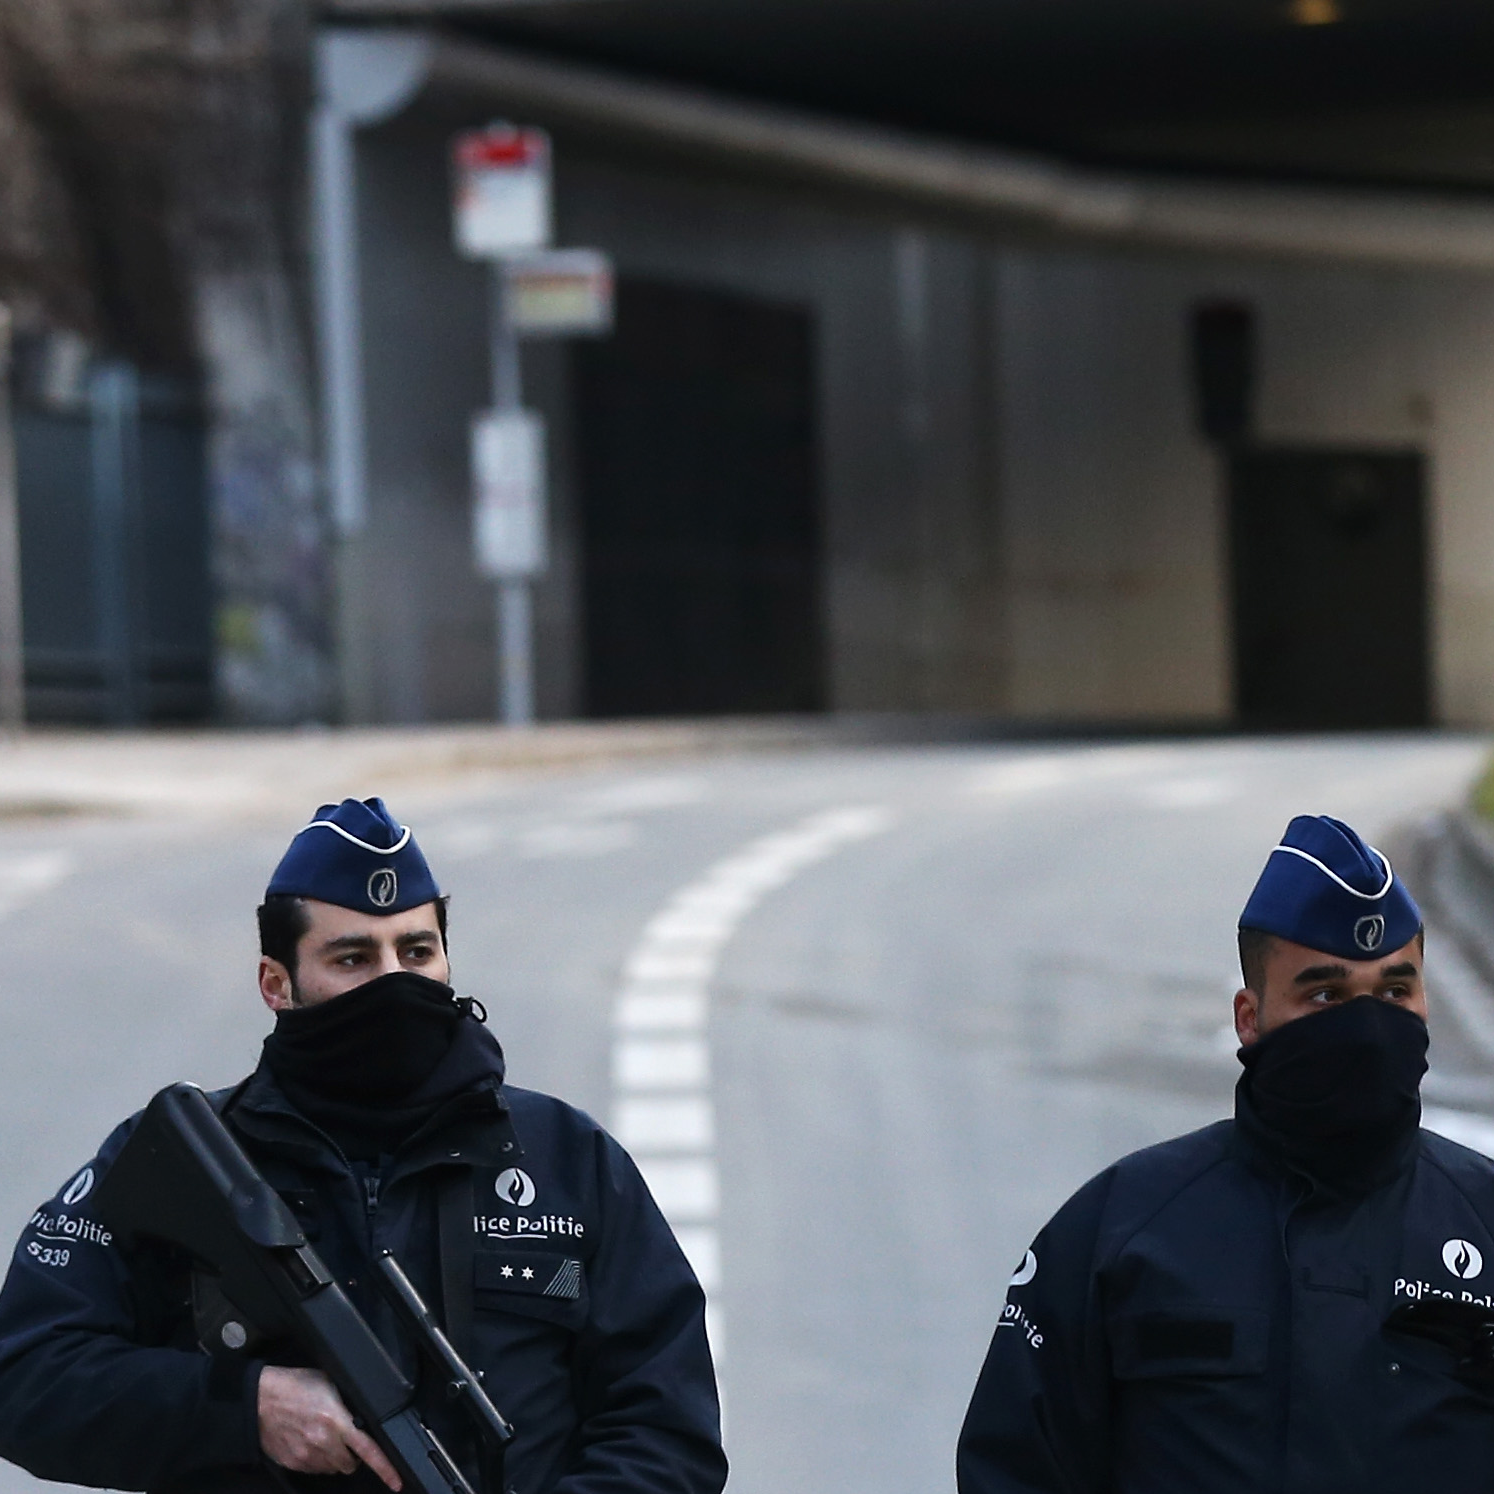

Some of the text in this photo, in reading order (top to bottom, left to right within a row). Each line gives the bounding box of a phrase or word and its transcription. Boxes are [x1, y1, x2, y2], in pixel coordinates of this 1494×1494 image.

[56, 1214, 112, 1246] Politie
[473, 1215, 584, 1238] lice Politie
[1394, 1278, 1454, 1300] Poli
[1004, 1304, 1043, 1348] olitie
